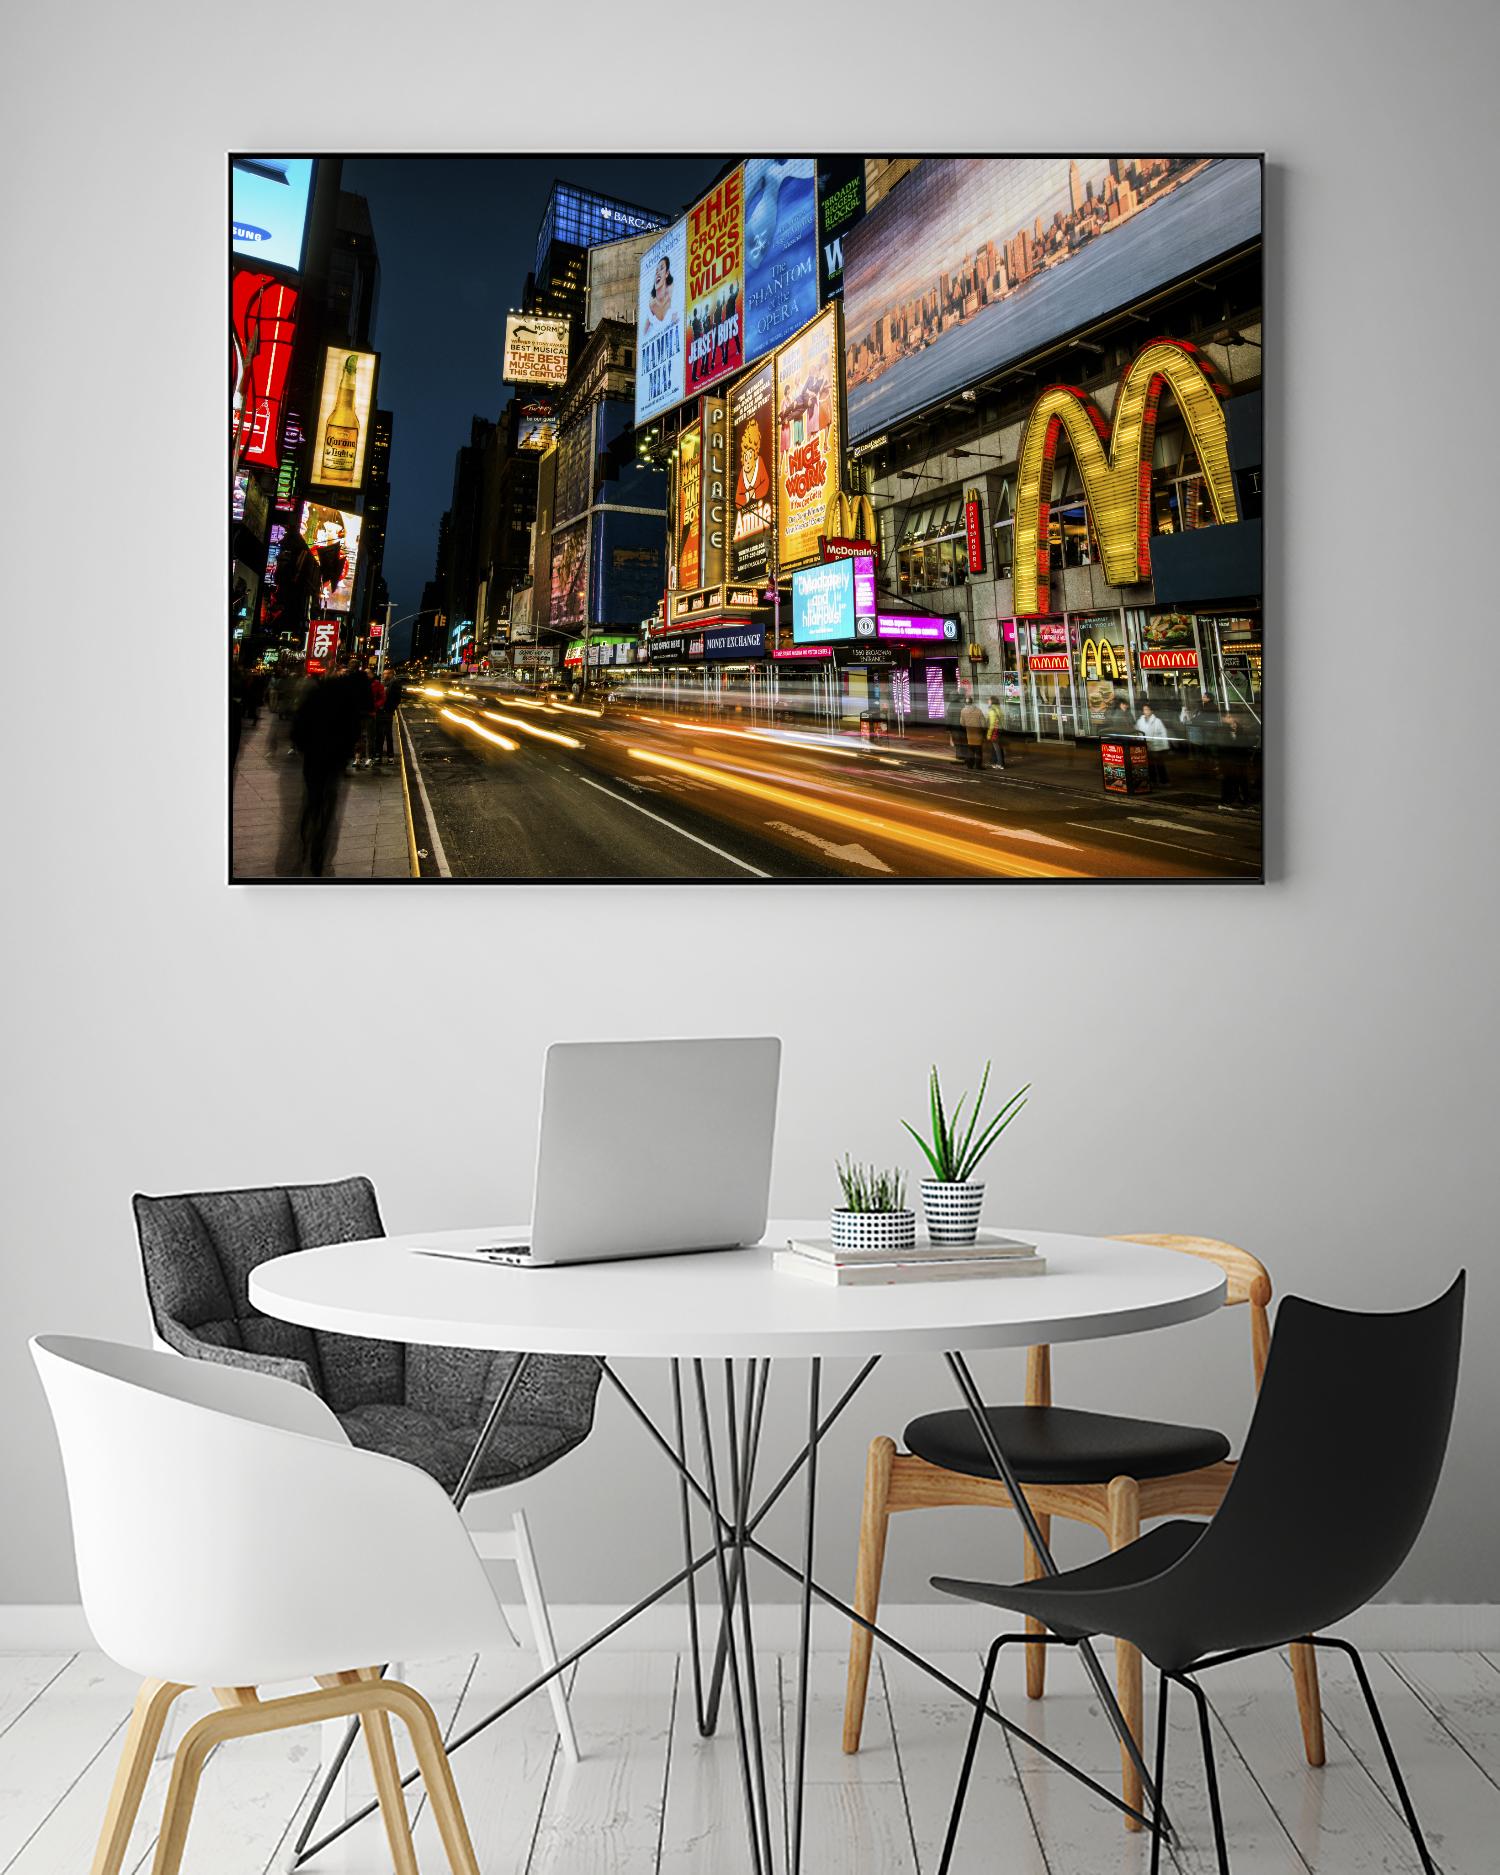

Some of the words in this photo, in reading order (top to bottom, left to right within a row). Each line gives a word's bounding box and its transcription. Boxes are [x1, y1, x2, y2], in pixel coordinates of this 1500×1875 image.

[690, 171, 740, 237] THE
[825, 187, 858, 219] BIGGEST
[690, 204, 740, 256] CROWD
[689, 222, 740, 278] GOES
[689, 245, 740, 301] WILD!
[748, 256, 813, 311] PHANTOM
[757, 298, 800, 334] OPERA
[533, 346, 569, 355] MUSICAL
[641, 325, 681, 377] MAMMA
[688, 327, 717, 365] JERSEY
[717, 313, 739, 347] BOYS
[509, 361, 553, 372] MUSICAL
[554, 365, 568, 373] OF
[509, 368, 528, 376] THIS
[529, 370, 567, 379] CENTURY
[537, 353, 569, 366] BEST
[648, 359, 672, 401] MIA!
[326, 435, 356, 447] Corona
[788, 436, 820, 475] NICE
[710, 408, 723, 549] PALACE
[785, 458, 828, 499] WORK
[733, 500, 772, 541] Annie
[826, 544, 878, 558] McDonald's
[729, 588, 759, 607] Annie
[313, 623, 335, 658] tkts
[706, 637, 725, 650] MONEY
[726, 633, 761, 648] EXCHANGE
